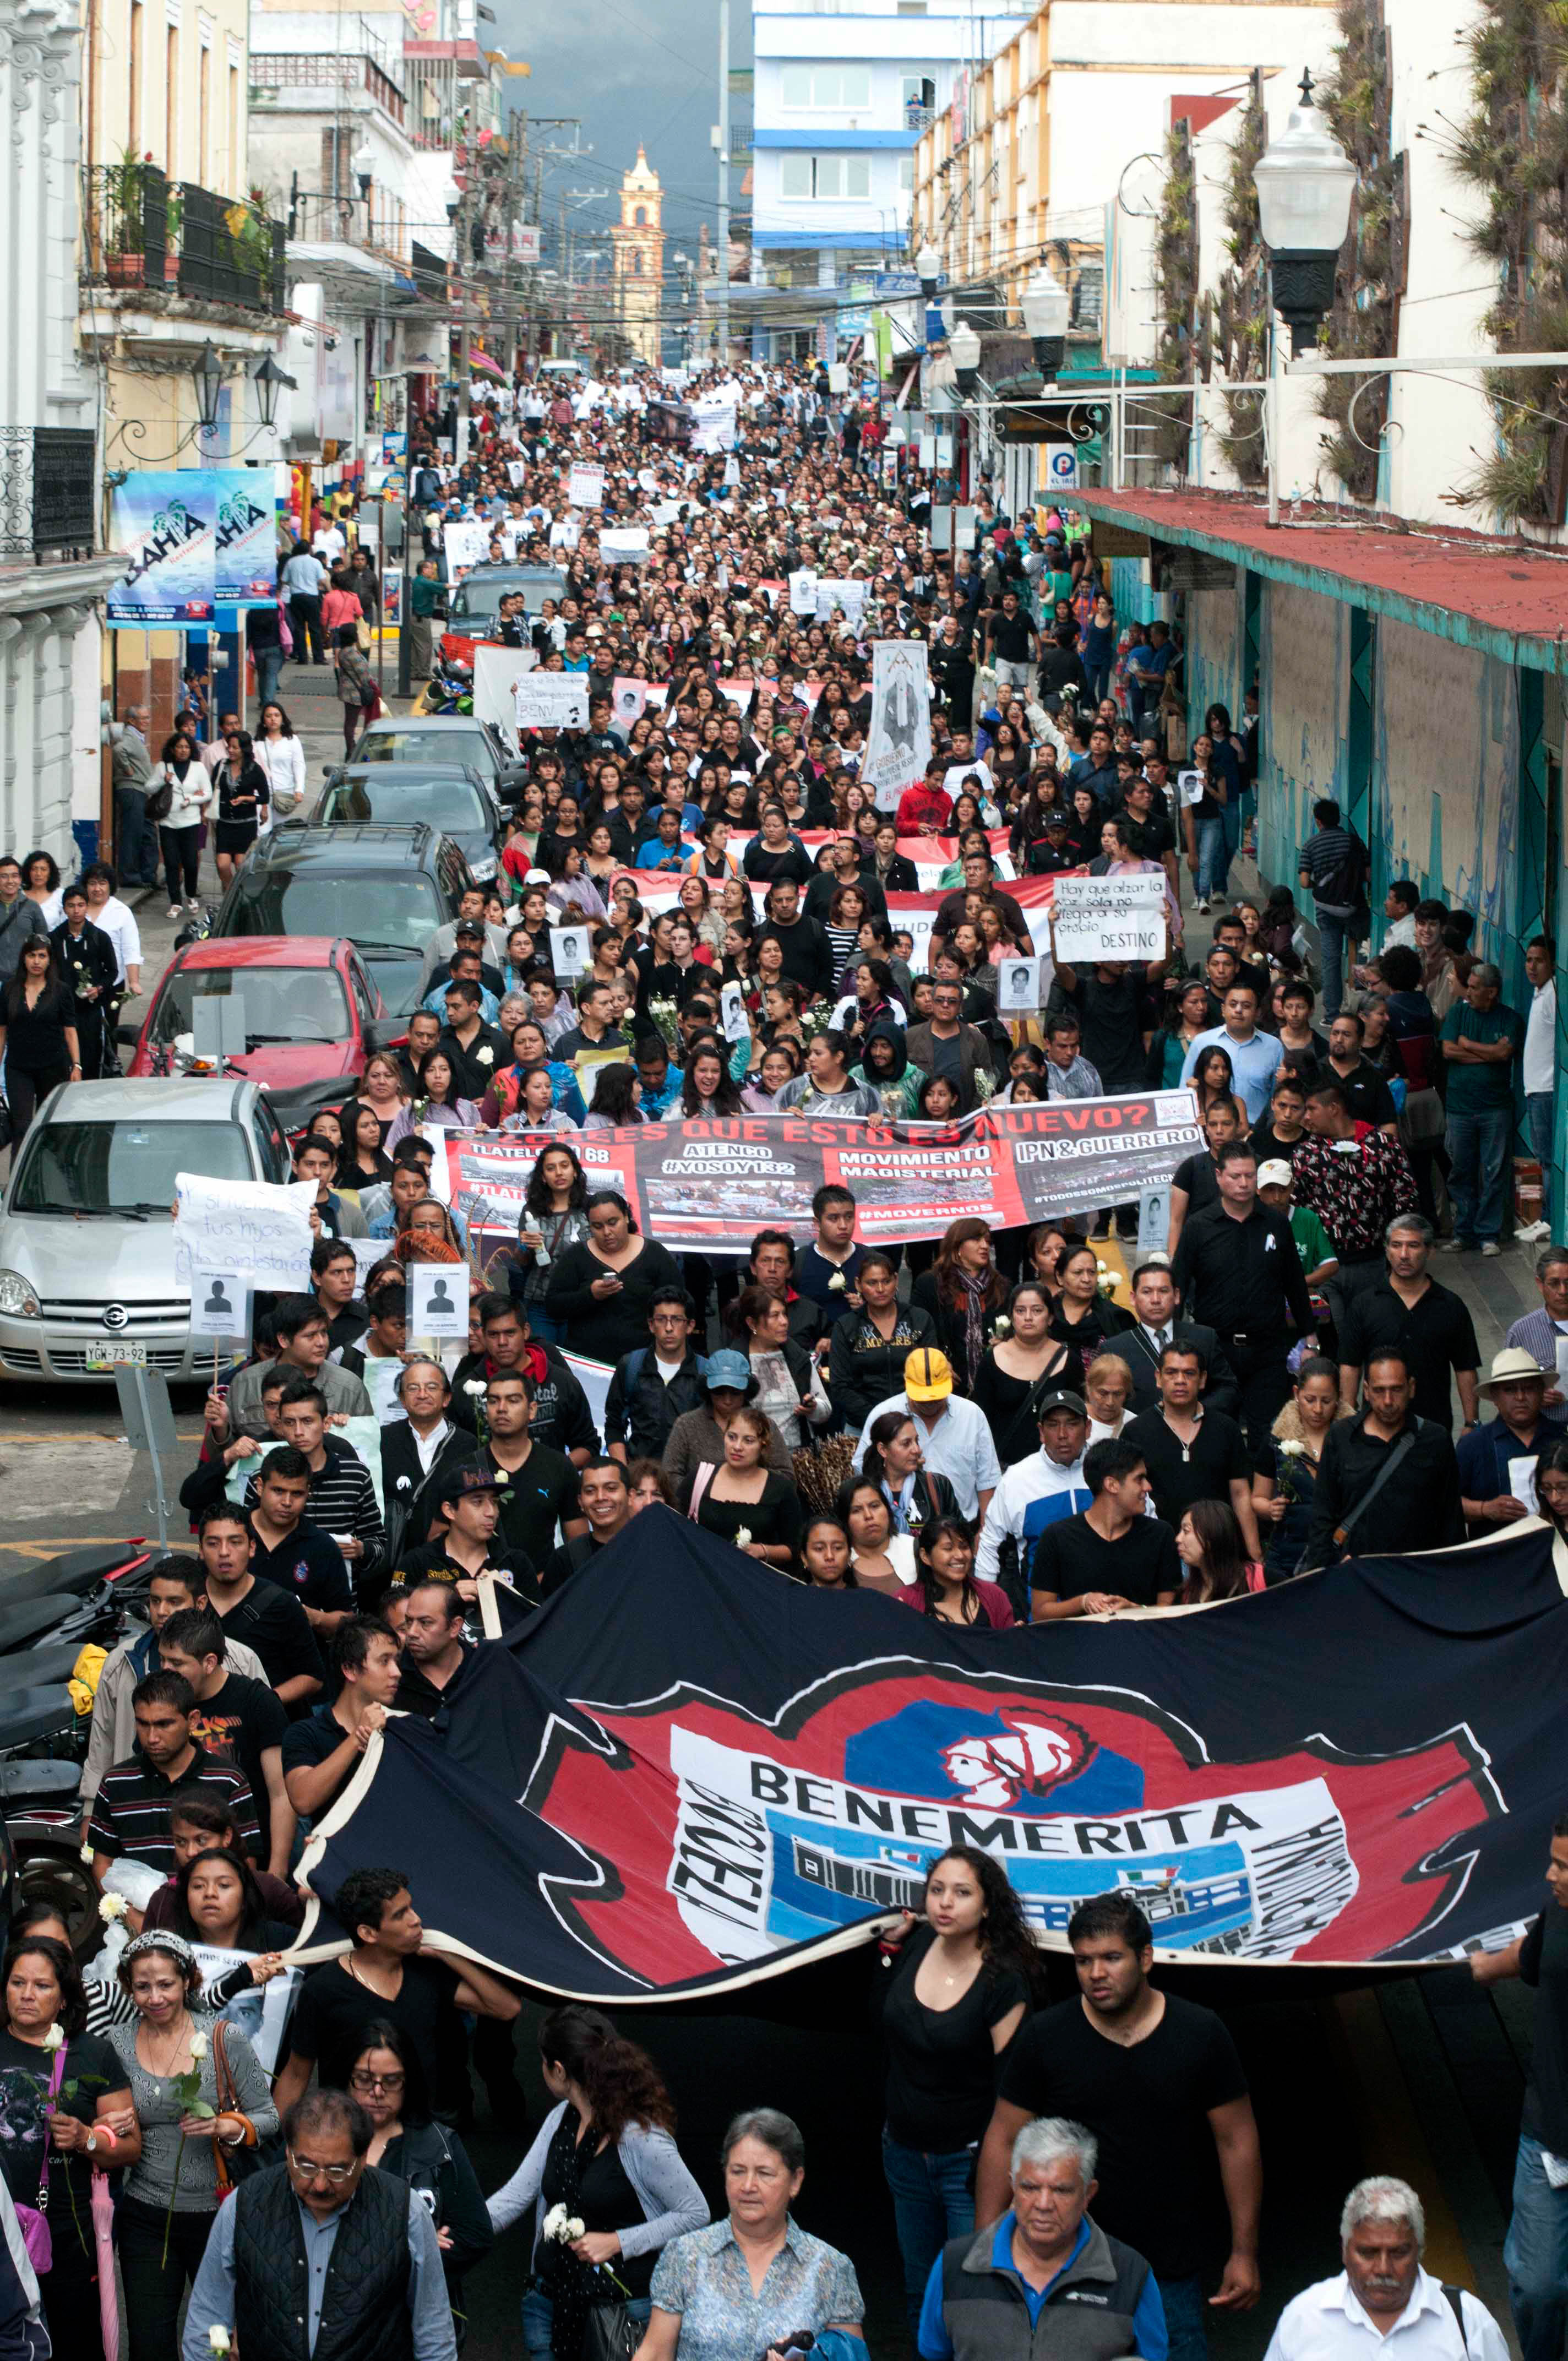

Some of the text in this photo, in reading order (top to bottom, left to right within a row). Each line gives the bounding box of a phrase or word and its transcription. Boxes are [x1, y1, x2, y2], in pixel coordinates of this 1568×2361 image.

[1061, 879, 1163, 897] Hay que alzar la
[1086, 896, 1112, 907] sola
[1117, 897, 1133, 906] no
[1097, 909, 1107, 918] a
[1114, 909, 1128, 918] su
[1058, 922, 1100, 937] propio
[1101, 932, 1158, 948] DESTINO
[681, 1119, 769, 1141] QUE
[783, 1120, 894, 1146] ESTO
[974, 1105, 1150, 1140] NUEVO?
[584, 1146, 610, 1163] 68
[684, 1143, 772, 1159] ATENCO
[838, 1145, 991, 1166] MOVIMIENTO
[662, 1160, 796, 1176] #YOSOY132
[840, 1166, 1000, 1179] MAGISTERIAL
[858, 1204, 994, 1220] #MOVERNOS
[203, 1214, 283, 1243] tus hijos
[88, 1347, 144, 1361] YGW-73-92
[750, 1760, 1264, 1854] BENEMERITA
[233, 1960, 248, 1968] LO
